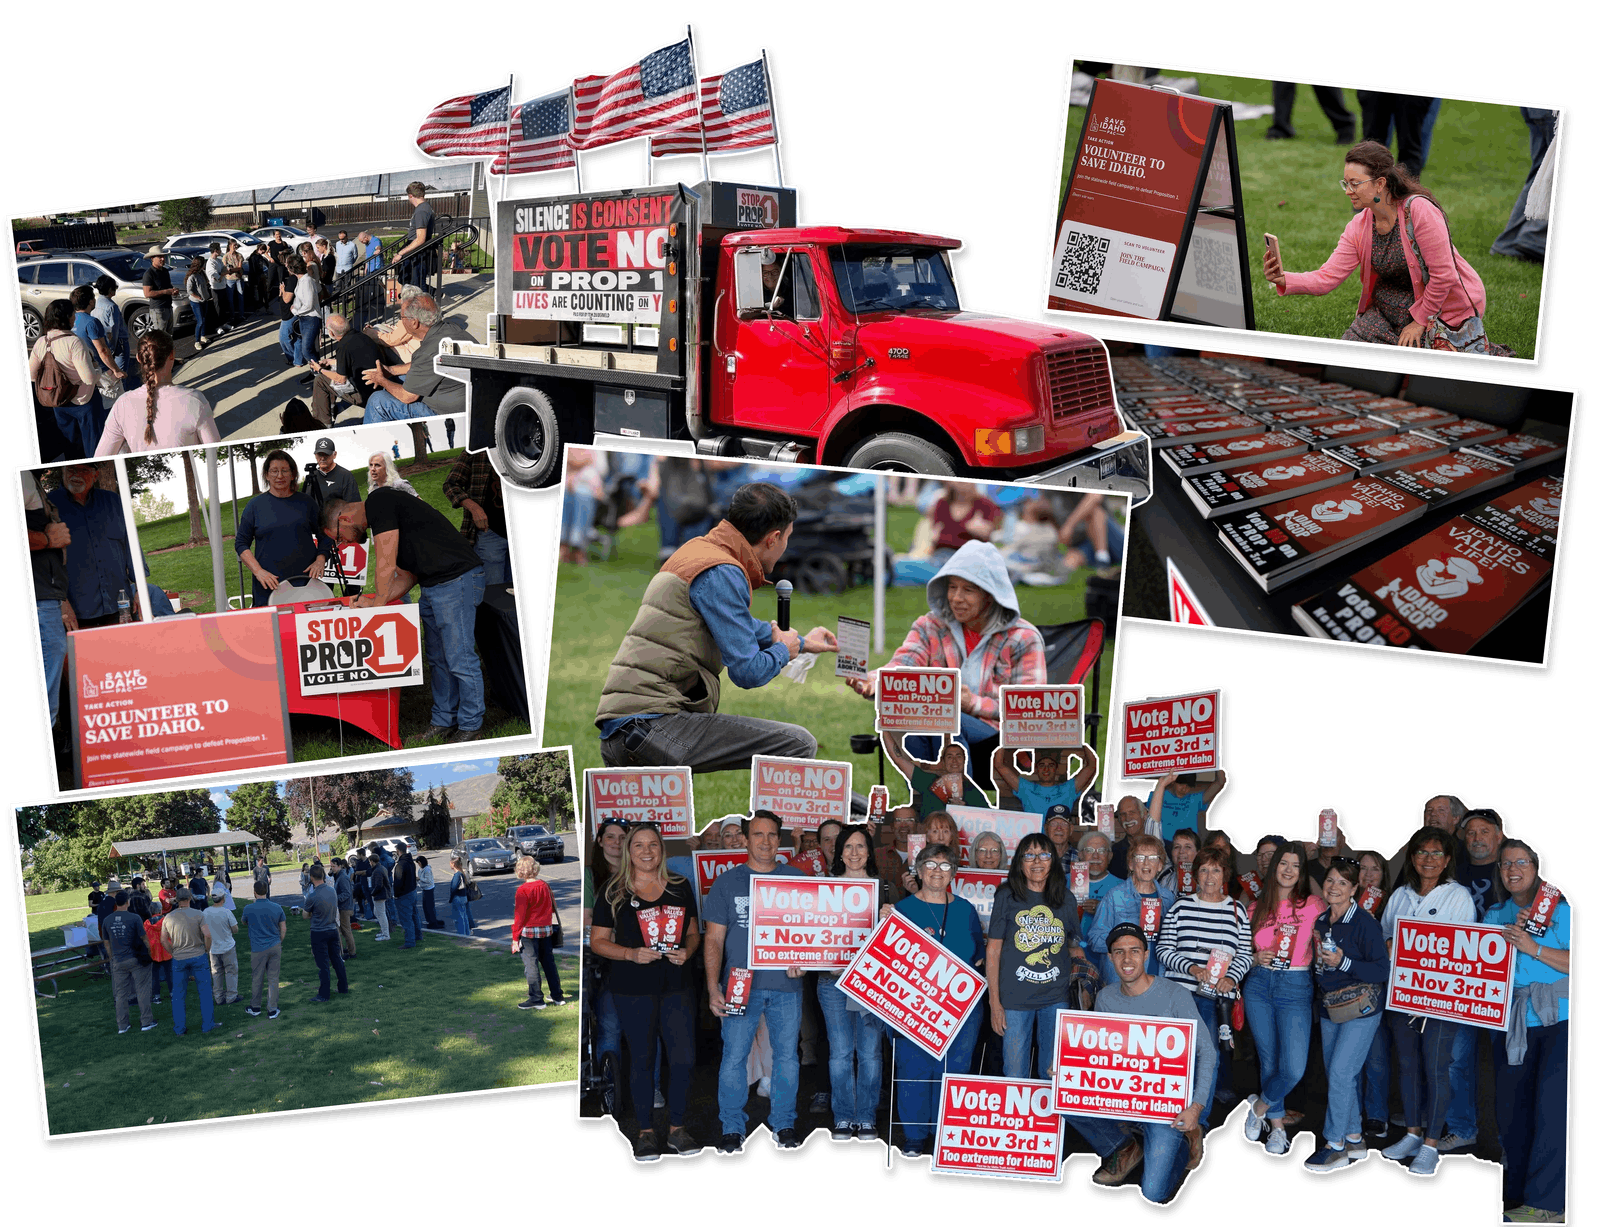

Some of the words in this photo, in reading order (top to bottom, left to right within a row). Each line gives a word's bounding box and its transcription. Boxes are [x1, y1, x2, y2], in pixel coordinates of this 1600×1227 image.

[1100, 122, 1126, 133] IDAHO
[1104, 116, 1125, 126] SAVE
[1098, 138, 1114, 146] ACTION
[1080, 155, 1108, 171] SAVE
[1108, 161, 1146, 179] IDAHO.
[1084, 143, 1147, 167] VOLUNTEER
[1149, 158, 1166, 171] TO
[741, 192, 760, 206] STOP
[516, 204, 570, 233] SILENCE
[572, 202, 587, 229] IS
[591, 195, 674, 228] CONSENT
[739, 205, 763, 222] PROP
[763, 199, 774, 224] 1
[519, 232, 609, 270] VOTE
[616, 227, 669, 268] NO
[1120, 252, 1133, 260] JOIN
[1134, 254, 1145, 262] THE
[1142, 245, 1165, 254] VOLUNTEER
[1119, 257, 1135, 266] FIELD
[1136, 260, 1165, 273] CAMPAIGN.
[530, 276, 544, 287] ON
[551, 271, 641, 290] PROP
[649, 271, 664, 290] 1
[516, 293, 549, 309] LIVES
[552, 296, 567, 309] ARE
[571, 293, 634, 311] COUNTING
[638, 297, 649, 308] ON
[888, 347, 909, 355] 4700
[1351, 482, 1405, 511] VALUES
[1351, 491, 1380, 509] LIFE!
[1368, 482, 1404, 501] IDAHO
[1238, 524, 1268, 547] PROP
[1246, 511, 1270, 531] Vote
[1264, 527, 1289, 545] NO
[1278, 543, 1298, 558] on
[1287, 522, 1311, 538] GOP
[1293, 514, 1324, 535] IDAHO
[1222, 523, 1253, 552] November
[1249, 551, 1267, 567] 3rd
[1448, 526, 1531, 575] VALUES
[1467, 526, 1522, 557] IDAHO
[1453, 543, 1498, 571] LIFE!
[1337, 583, 1377, 620] Vote
[1373, 613, 1412, 645] NO
[1400, 585, 1449, 623] IDAHO
[1399, 605, 1437, 630] GOP
[308, 616, 362, 643] STOP
[300, 639, 372, 673] PROP
[374, 621, 404, 666] 1
[100, 675, 148, 690] IDAHO
[105, 669, 141, 681] SAVE
[307, 673, 345, 684] VOTE
[349, 671, 369, 680] NO
[883, 676, 917, 692] Vote
[920, 674, 953, 694] NO
[84, 702, 103, 710] TAKE
[105, 699, 134, 708] ACTION
[1007, 694, 1041, 709] Vote
[1043, 692, 1076, 710] NO
[84, 703, 198, 729] VOLUNTEER
[202, 699, 229, 715] TO
[1130, 709, 1169, 728] Vote
[1172, 698, 1213, 725] NO
[85, 726, 133, 744] SAVE
[137, 717, 205, 738] IDAHO.
[1146, 729, 1159, 738] on
[1162, 726, 1187, 736] Prop
[1190, 723, 1195, 733] 1
[86, 755, 99, 764] Join
[100, 753, 111, 761] the
[112, 749, 144, 760] statewide
[145, 747, 160, 755] field
[160, 744, 194, 754] campaign
[202, 740, 224, 748] defeat
[225, 736, 261, 747] Proposition
[1140, 742, 1170, 756] Nov
[1174, 737, 1200, 752] 3rd
[1128, 761, 1141, 770] Too
[1142, 758, 1175, 769] extreme
[1176, 756, 1188, 766] for
[1189, 753, 1212, 764] Idaho
[596, 779, 639, 796] Vote
[641, 775, 682, 796] NO
[762, 767, 801, 785] Vote
[804, 767, 843, 790] NO
[772, 798, 802, 811] Nov
[805, 800, 830, 813] 3rd
[759, 887, 814, 910] Vote
[817, 885, 870, 913] NO
[774, 928, 816, 944] Nov
[820, 929, 853, 945] 3rd
[1402, 928, 1450, 955] Vote
[1453, 929, 1507, 964] NO
[883, 922, 930, 969] Vote
[925, 953, 976, 1002] NO
[1420, 957, 1436, 968] on
[1439, 957, 1472, 975] Prop
[1476, 962, 1482, 975] 1
[891, 959, 909, 975] on
[907, 968, 938, 997] Prop
[939, 991, 948, 1003] 1
[1411, 972, 1449, 992] Nov
[1453, 978, 1487, 998] 3rd
[872, 966, 911, 1001] Nov
[910, 994, 943, 1024] 3rd
[1395, 990, 1411, 1003] Too
[1412, 994, 1452, 1010] extreme
[1454, 1000, 1469, 1013] for
[1471, 1003, 1501, 1019] Idaho
[849, 973, 866, 993] Too
[866, 986, 904, 1019] extreme
[904, 1013, 920, 1030] for
[917, 1023, 943, 1047] Idaho
[1066, 1023, 1123, 1051] Vote
[1127, 1024, 1186, 1059] NO
[1089, 1054, 1109, 1066] on
[1112, 1054, 1149, 1071] Prop
[1153, 1057, 1160, 1070] 1
[1080, 1070, 1124, 1091] Nov
[1129, 1075, 1166, 1095] 3rd
[950, 1085, 1002, 1112] Vote
[1004, 1085, 1053, 1118] NO
[1061, 1091, 1080, 1104] Too
[1082, 1095, 1129, 1108] extreme
[1131, 1098, 1148, 1110] for
[1150, 1099, 1182, 1114] Idaho
[970, 1114, 987, 1125] on
[990, 1113, 1024, 1130] Prop
[1027, 1116, 1034, 1128] 1
[960, 1129, 1000, 1148] Nov
[1005, 1133, 1039, 1151] 3rd
[942, 1149, 960, 1162] Too
[962, 1152, 1005, 1166] extreme
[1006, 1154, 1022, 1167] for
[1023, 1156, 1053, 1169] Idaho
